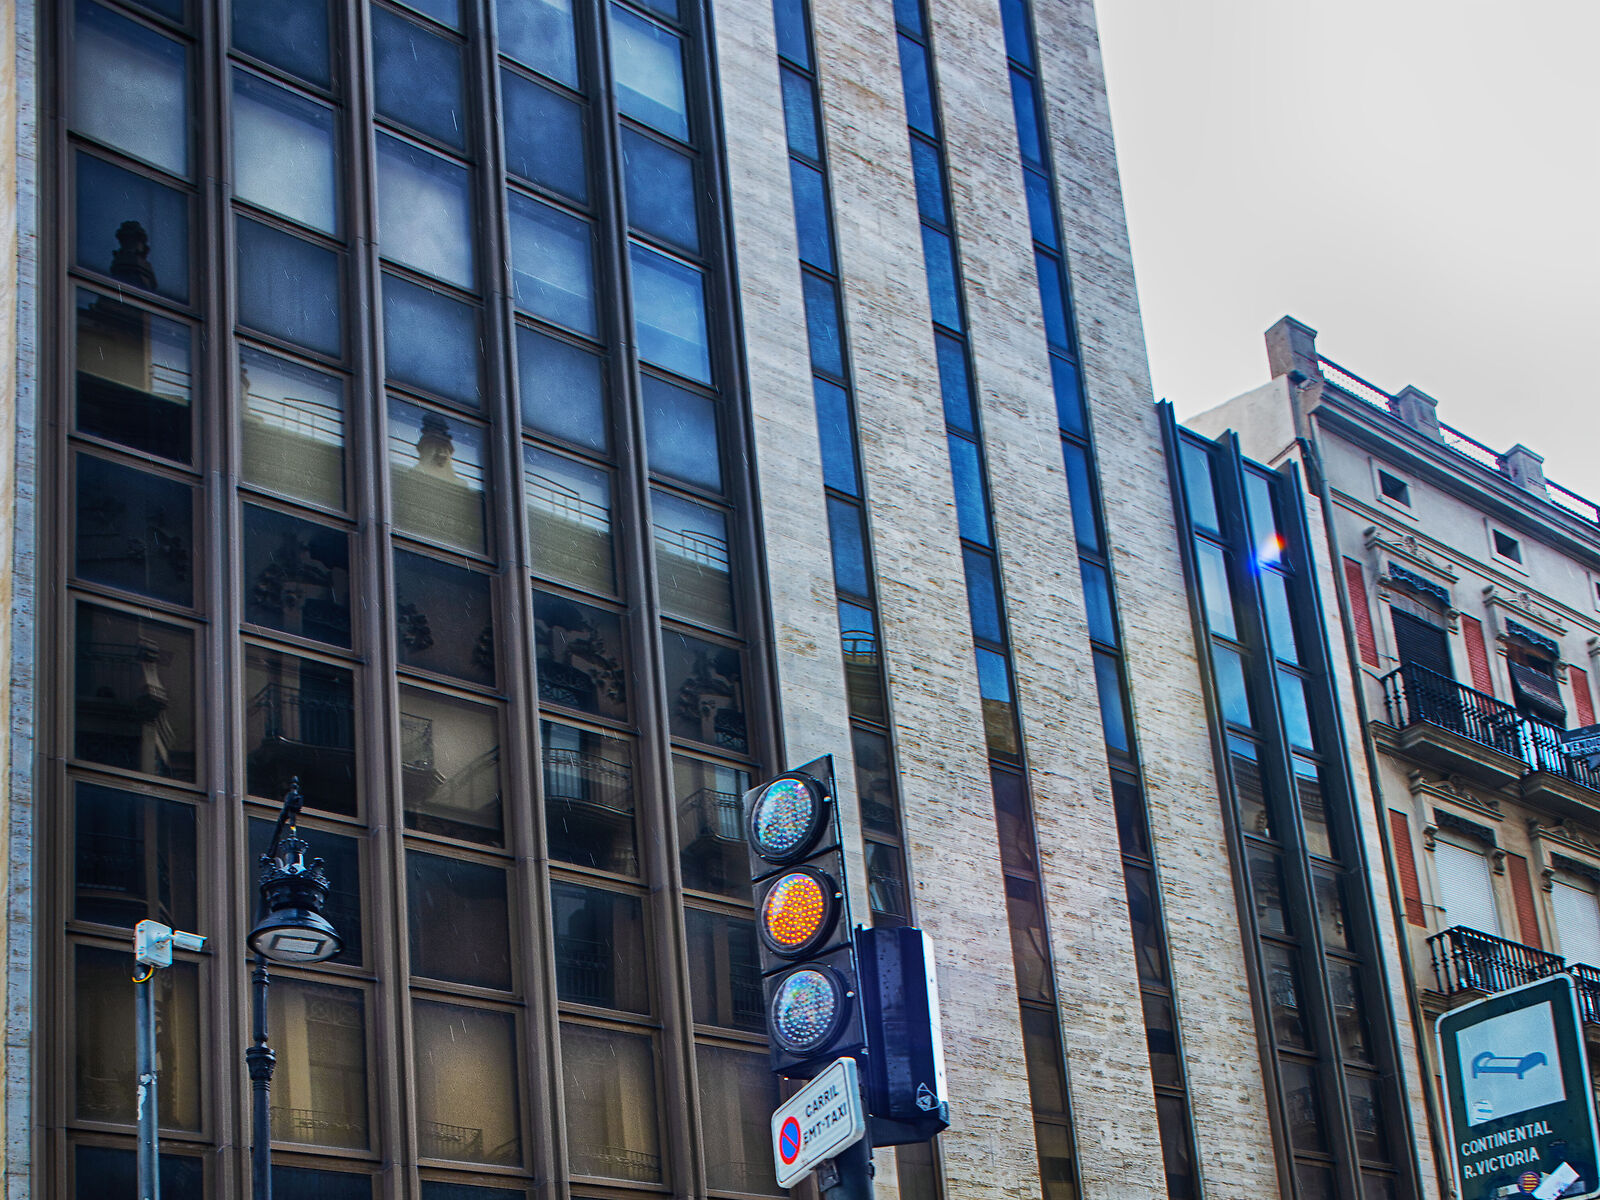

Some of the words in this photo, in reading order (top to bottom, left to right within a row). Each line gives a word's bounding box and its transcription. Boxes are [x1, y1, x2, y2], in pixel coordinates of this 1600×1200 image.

[805, 1085, 839, 1118] CARRIL
[803, 1102, 847, 1143] EMT-TAXI
[1461, 1120, 1553, 1156] CONTINENTAL
[1463, 1146, 1540, 1179] R.VICTORIA
